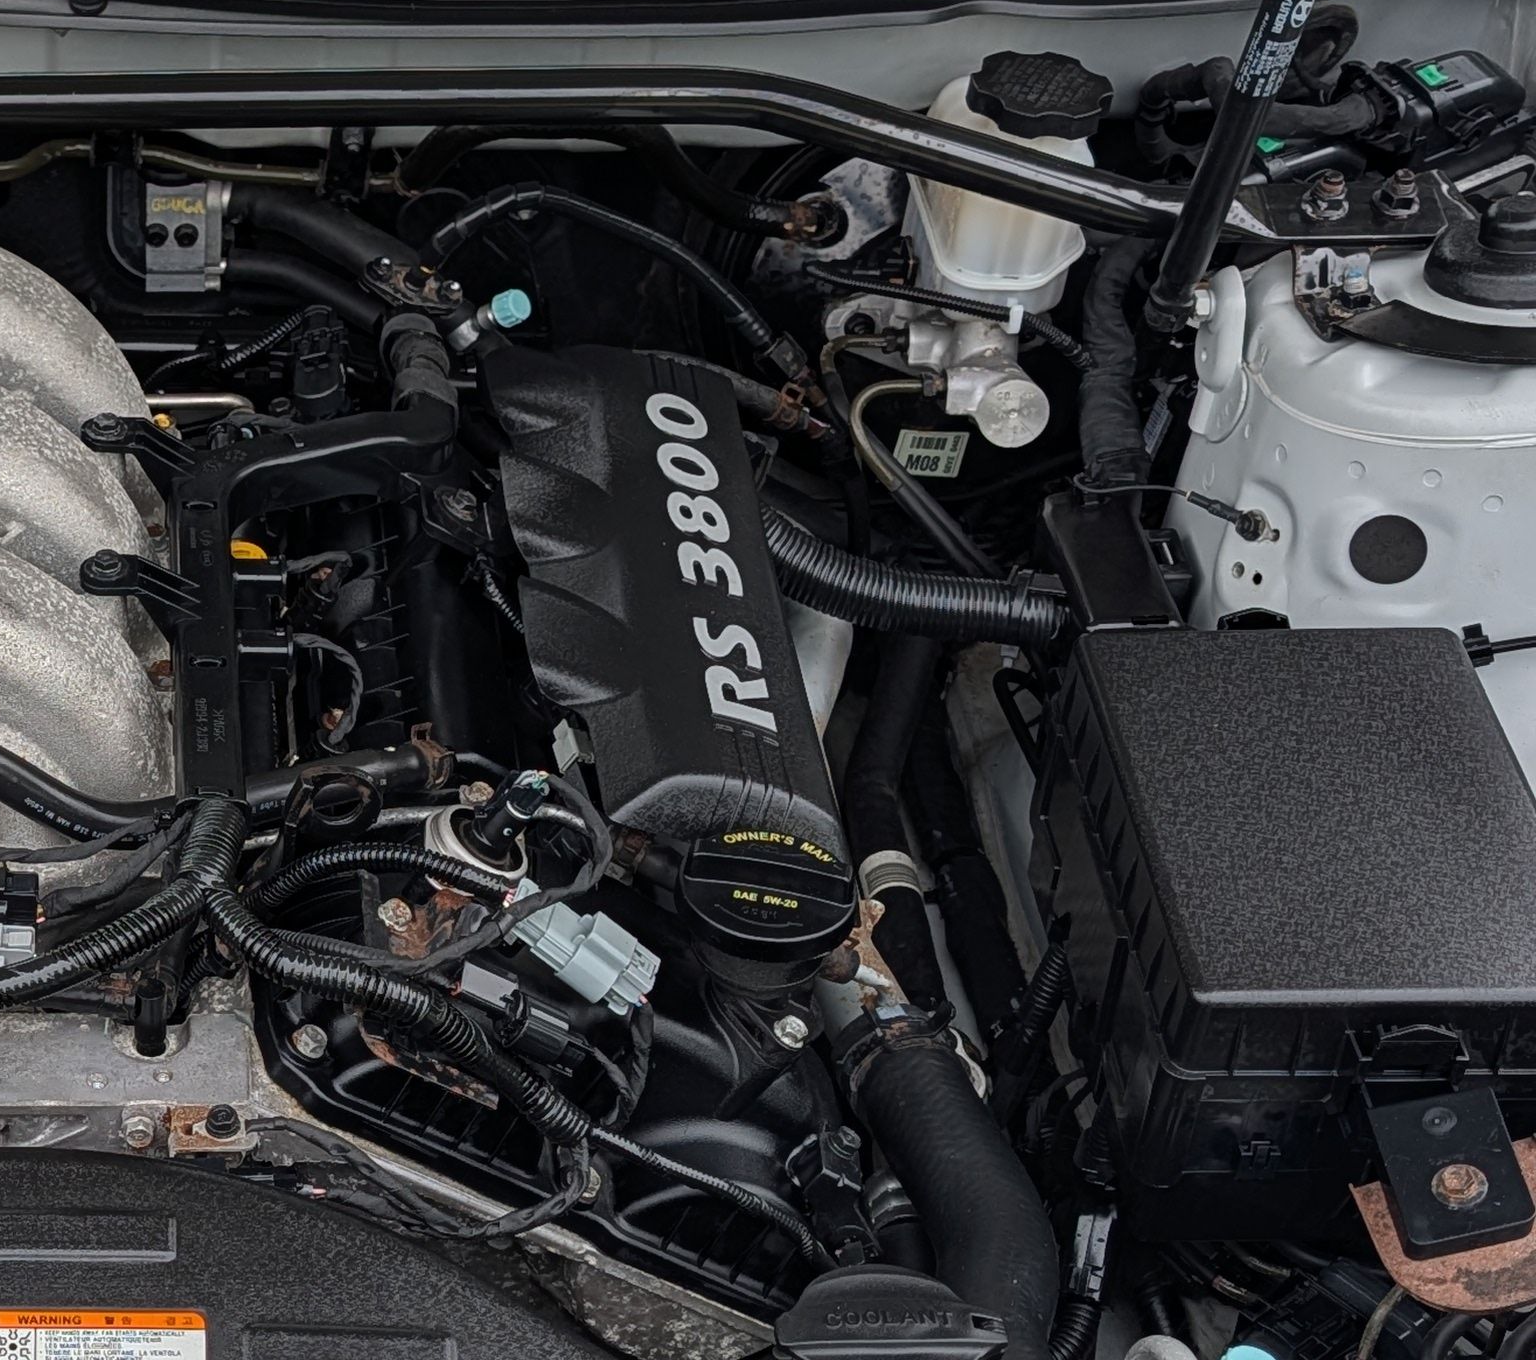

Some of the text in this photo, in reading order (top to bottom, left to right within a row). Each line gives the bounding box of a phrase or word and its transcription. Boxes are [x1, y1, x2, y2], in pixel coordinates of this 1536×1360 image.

[905, 454, 940, 473] M08
[645, 392, 778, 734] RS 3800
[723, 831, 795, 846] OWNER'S
[733, 890, 798, 909] SAE 5W-20
[17, 1315, 82, 1325] WARNING
[824, 1311, 954, 1330] COOLANT
